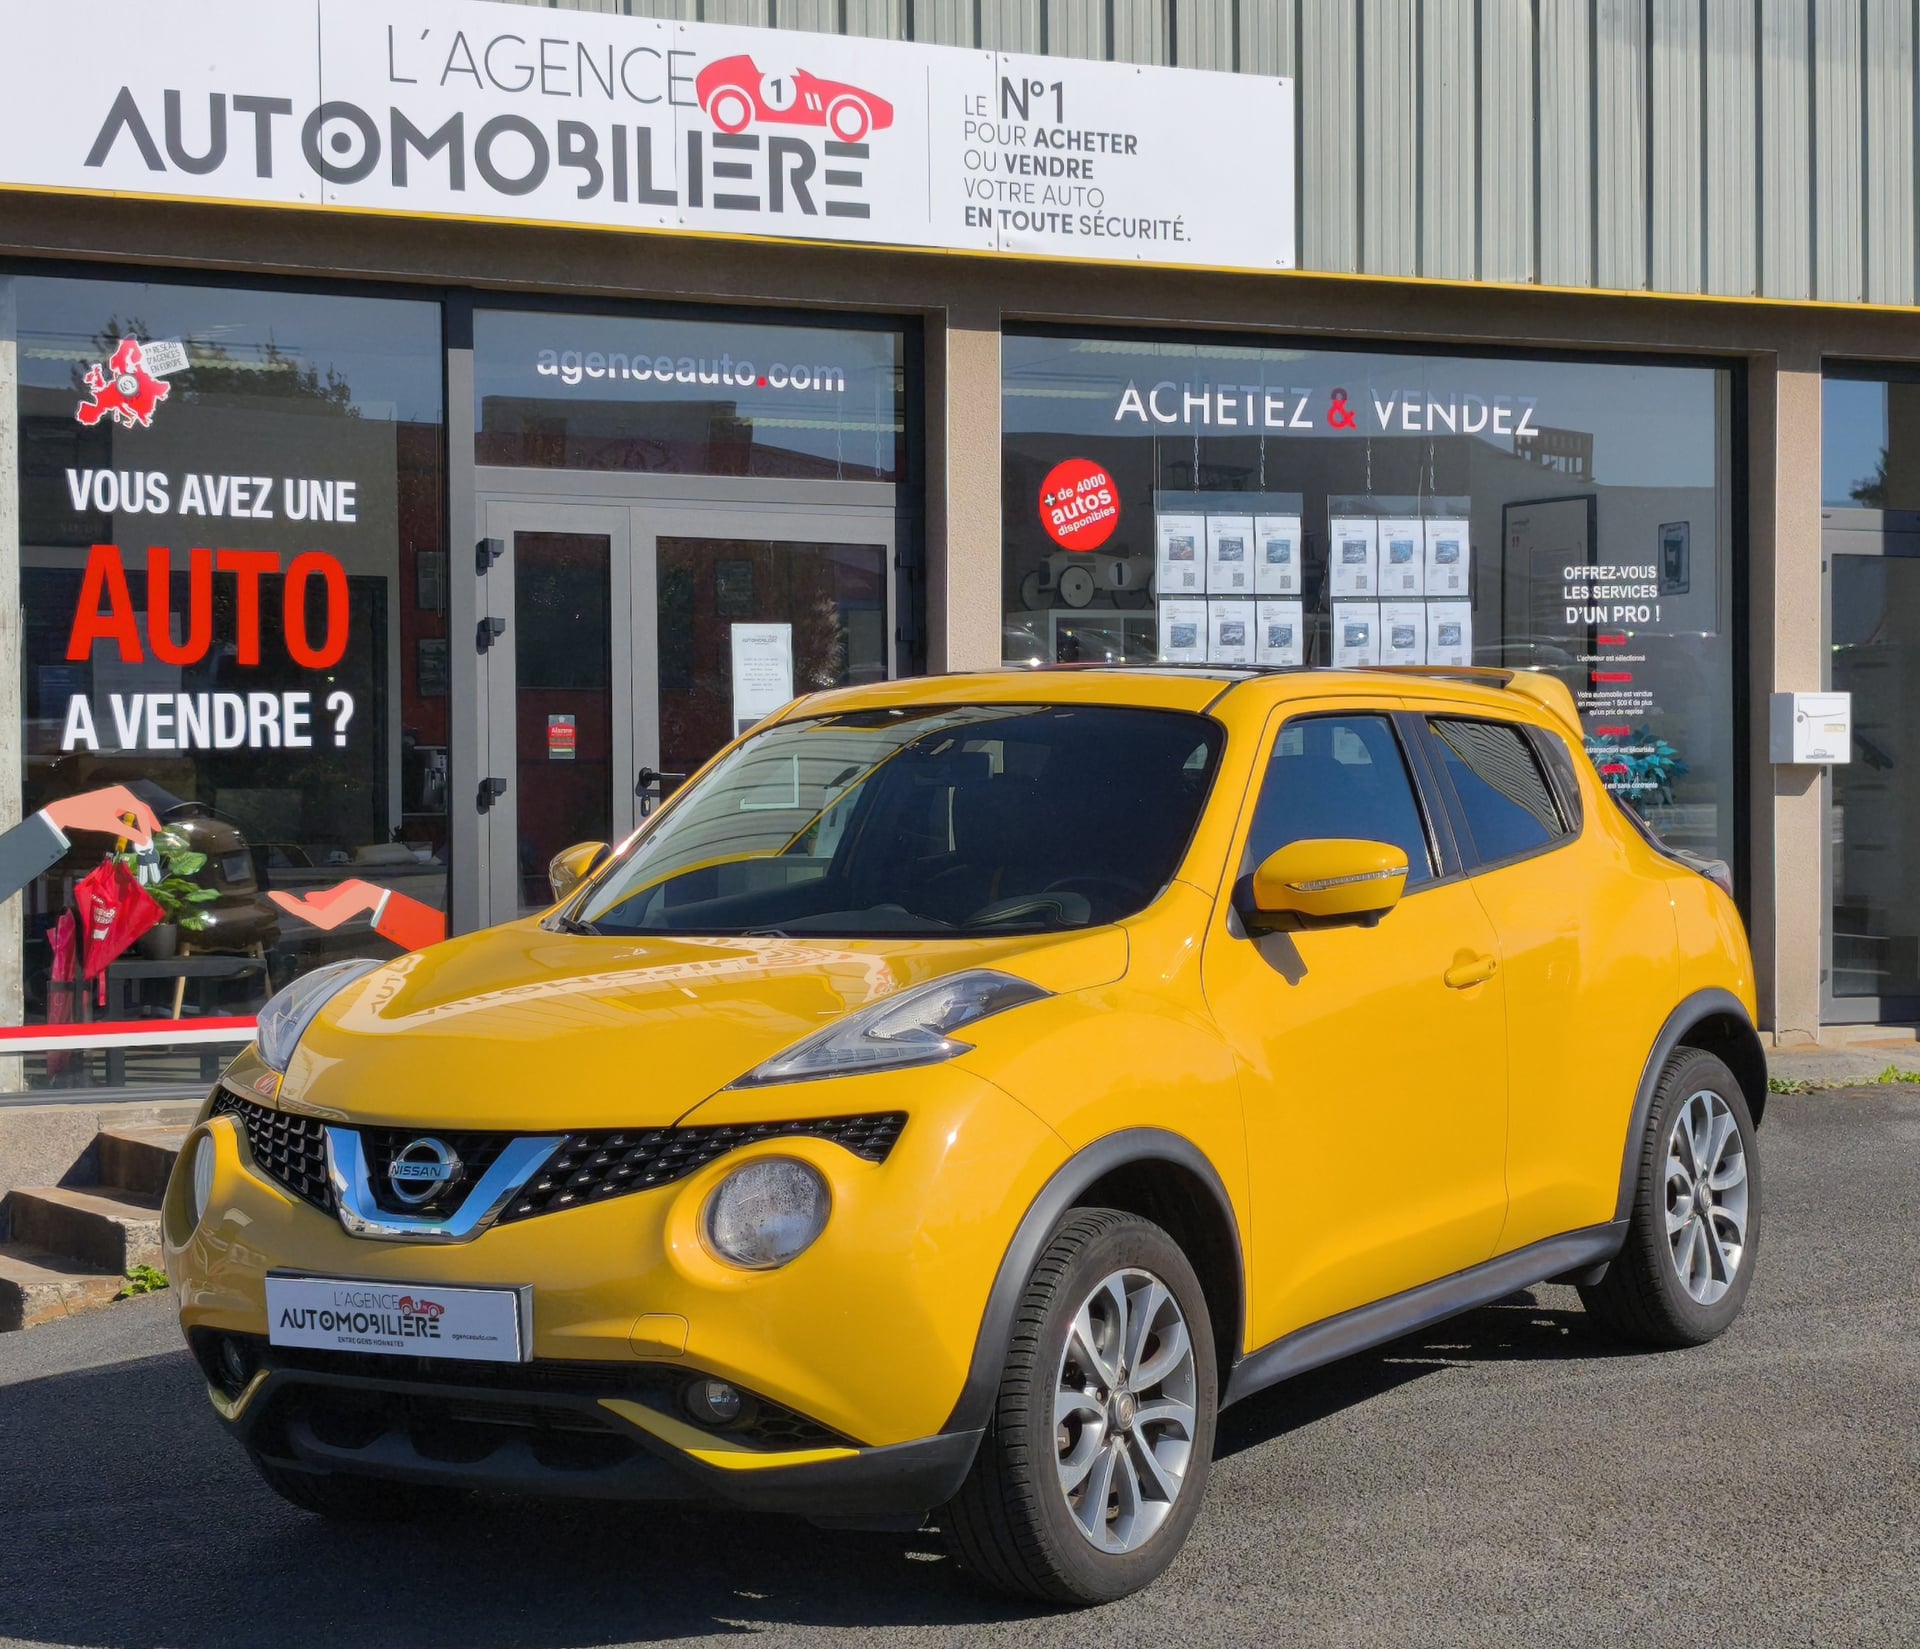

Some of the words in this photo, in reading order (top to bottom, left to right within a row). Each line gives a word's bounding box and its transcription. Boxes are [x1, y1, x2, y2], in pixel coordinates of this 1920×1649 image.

[387, 24, 698, 107] L'AGENCE
[964, 94, 988, 117] LE
[83, 86, 870, 219] AUTOMOBILIERE
[964, 120, 1027, 147] POUR
[1033, 127, 1138, 156] ACHETER
[963, 149, 997, 172] OU
[1004, 153, 1094, 180] VENDRE
[963, 177, 1036, 204] VOTRE
[1041, 184, 1105, 208] AUTO
[964, 206, 993, 228] EN
[998, 209, 1074, 235] TOUTE
[1079, 210, 1192, 242] SÉCURITÉ.
[536, 348, 845, 392] agenceauto.com
[1114, 378, 1314, 429] ACHETEZ
[1327, 387, 1357, 431] &
[1369, 387, 1540, 437] VENDEZ
[66, 468, 170, 515] VOUS
[178, 473, 274, 519] AVEZ
[284, 478, 357, 523] UNE
[1057, 487, 1074, 501] de
[1077, 473, 1106, 494] 4000
[1051, 489, 1112, 526] autos
[1058, 505, 1116, 536] disponibles
[1564, 566, 1657, 580] OFFREZ-VOUS
[65, 544, 351, 670] AUTO
[1564, 585, 1590, 600] LES
[1593, 584, 1658, 600] SERVICES
[1566, 606, 1608, 624] D'UN
[1613, 605, 1650, 623] PRO
[60, 694, 100, 752] A
[111, 691, 313, 750] VENDRE
[326, 690, 355, 748] ?
[391, 1165, 441, 1177] NISSAN
[334, 1291, 400, 1310] L'AGENCE
[280, 1307, 441, 1339] AUTOMOBILIERE
